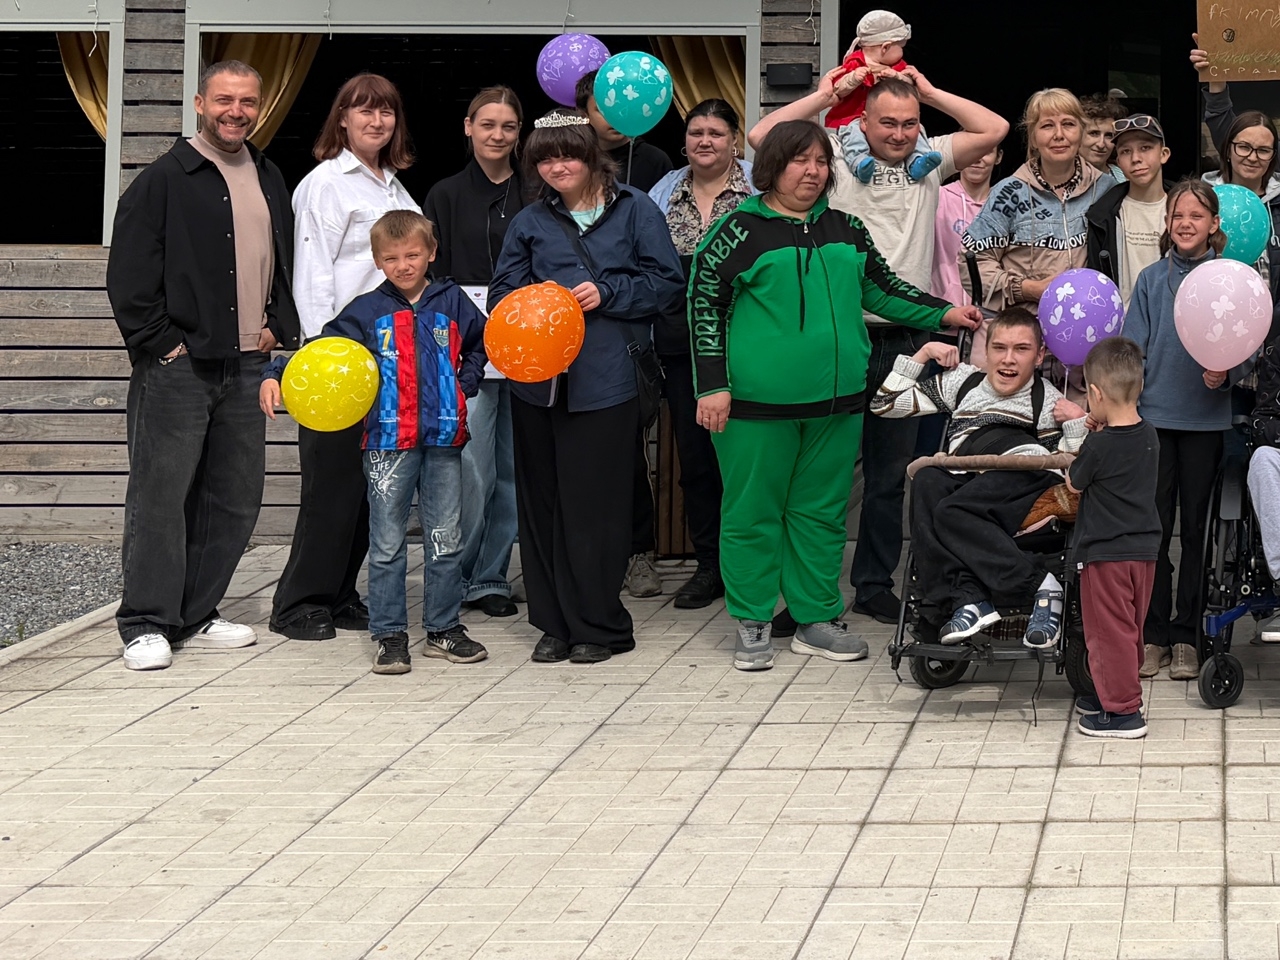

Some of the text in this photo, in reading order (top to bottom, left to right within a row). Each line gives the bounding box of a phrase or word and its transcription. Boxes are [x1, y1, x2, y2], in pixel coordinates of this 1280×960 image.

[991, 180, 1023, 213] TWINS
[380, 329, 392, 351] 7
[373, 460, 391, 472] LIFE
